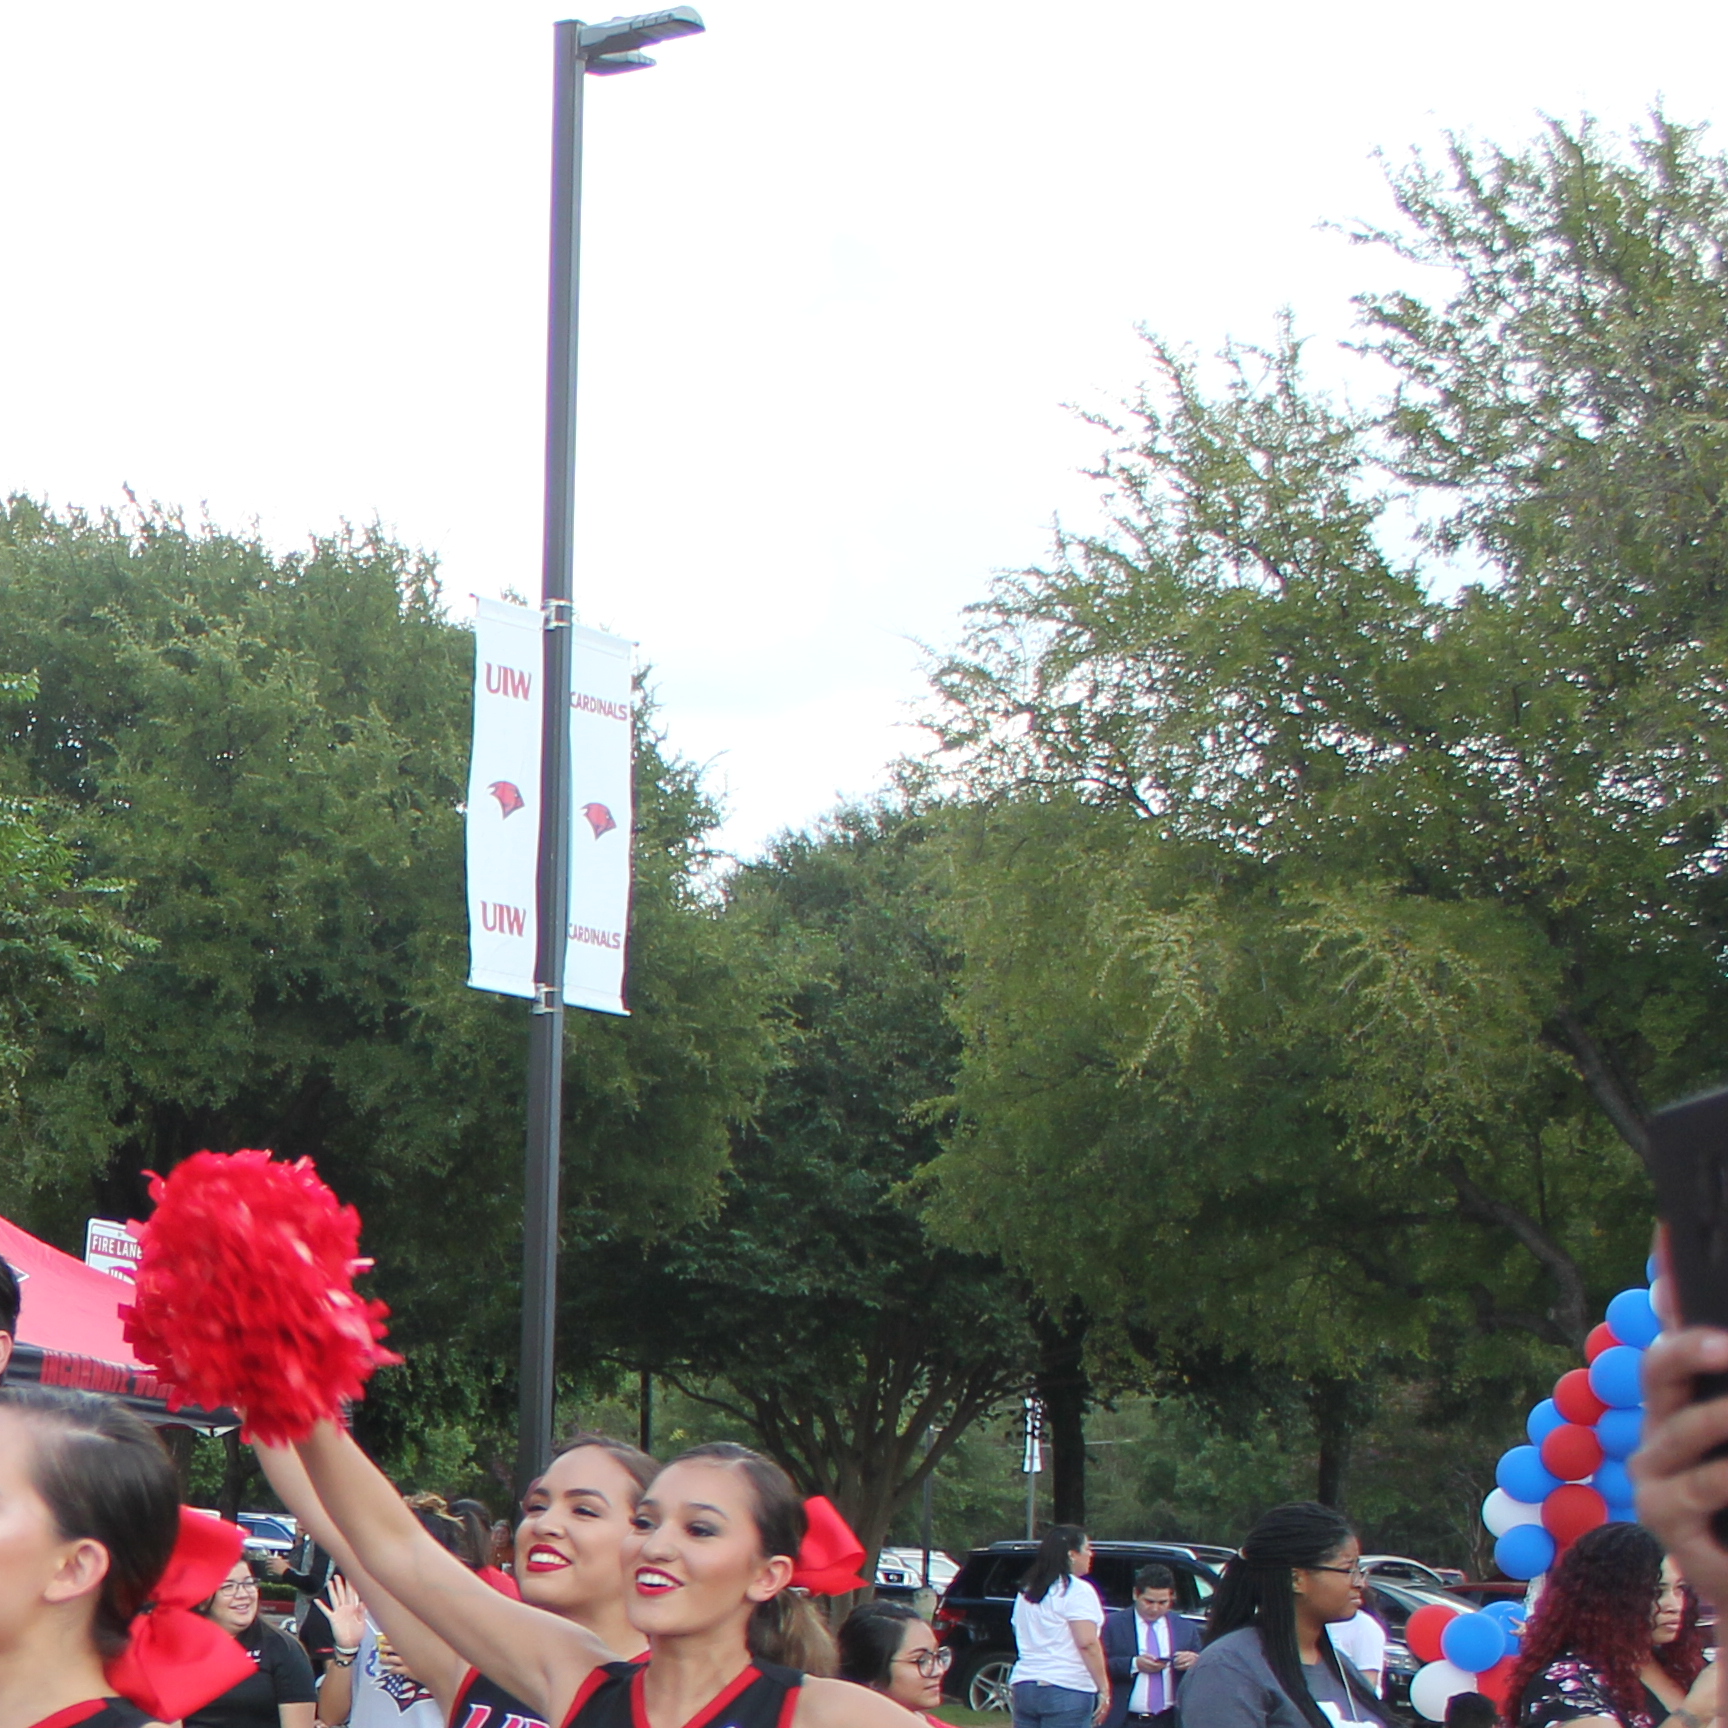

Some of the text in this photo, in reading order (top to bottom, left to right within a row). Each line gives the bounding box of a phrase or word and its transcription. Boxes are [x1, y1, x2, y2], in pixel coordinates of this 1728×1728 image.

[485, 662, 532, 701] UIW
[570, 691, 627, 721] CARDINALS
[481, 900, 526, 938] UIW
[567, 923, 621, 949] CARDINALS
[92, 1236, 114, 1254] FIRE
